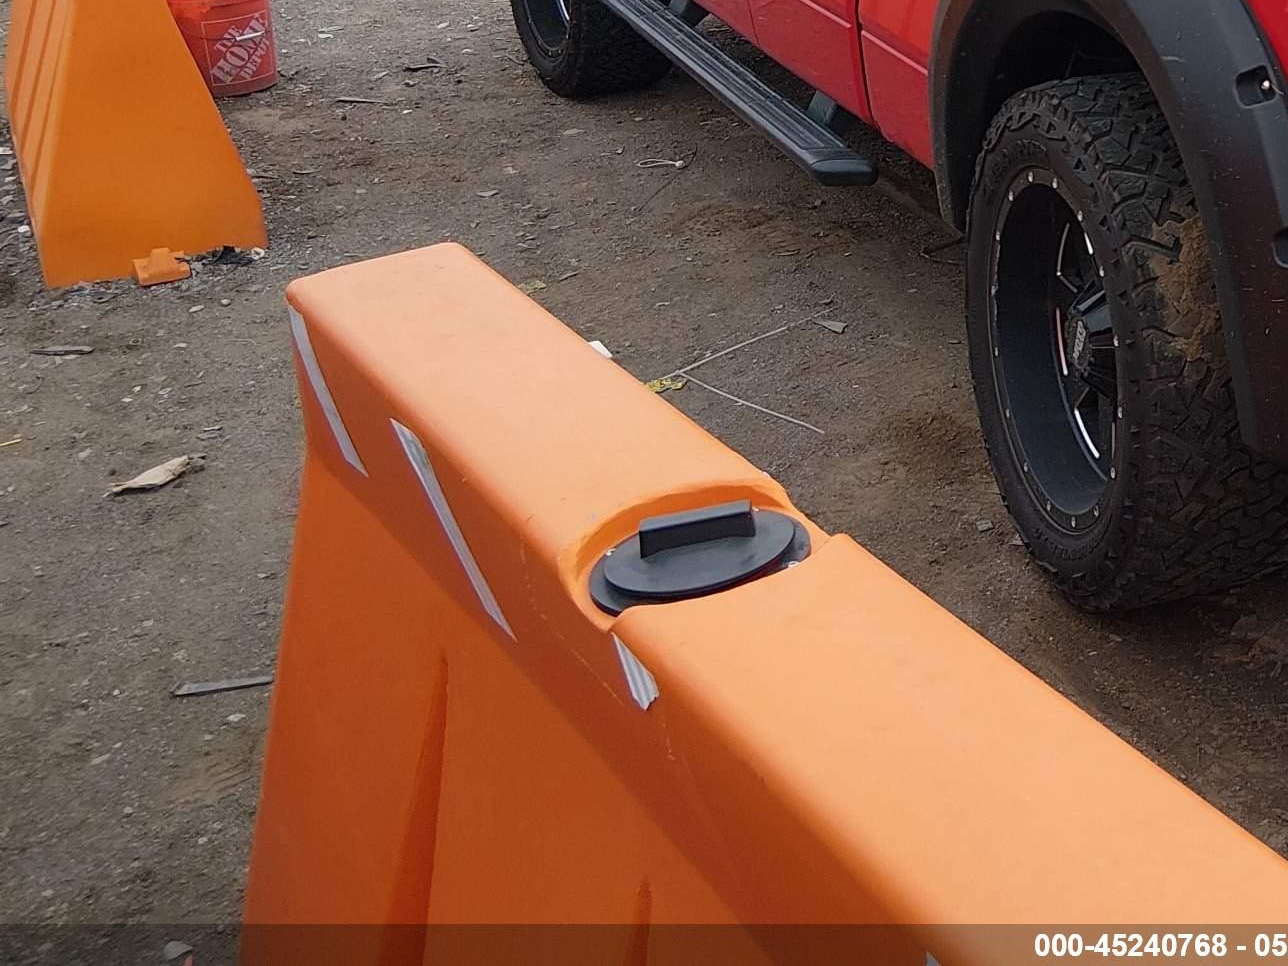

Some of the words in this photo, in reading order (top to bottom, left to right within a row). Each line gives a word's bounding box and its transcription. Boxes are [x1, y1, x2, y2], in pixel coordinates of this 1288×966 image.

[211, 13, 267, 85] HOME
[214, 25, 243, 54] THE
[239, 37, 271, 81] DEPOT
